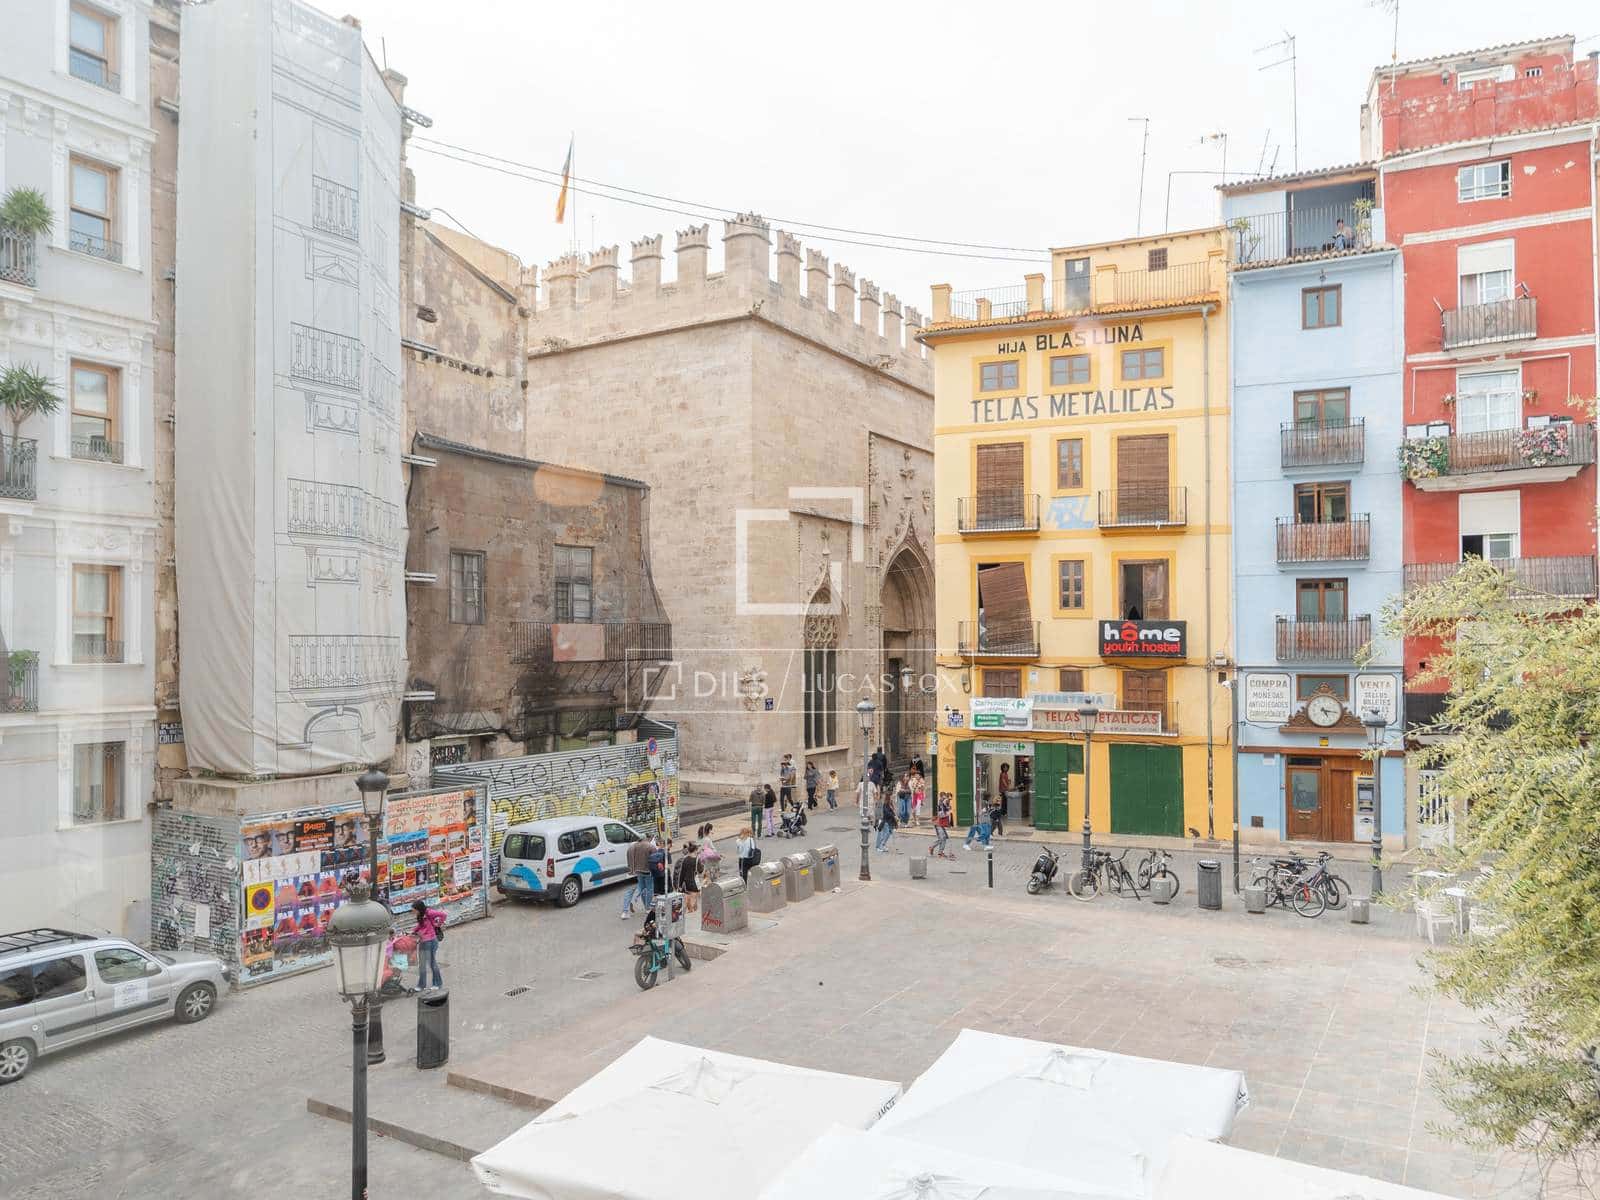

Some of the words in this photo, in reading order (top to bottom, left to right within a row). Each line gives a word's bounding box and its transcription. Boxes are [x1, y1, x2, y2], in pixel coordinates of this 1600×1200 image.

[998, 341, 1027, 355] HIJA
[1036, 332, 1087, 351] BLAS
[1093, 325, 1144, 345] LUNA
[971, 395, 1039, 424] TELAS
[1050, 386, 1175, 418] METALICAS
[1103, 642, 1139, 655] youth
[1141, 642, 1181, 653] hostel
[1249, 679, 1288, 688] COMPRA
[1359, 680, 1392, 689] VENTA
[1044, 711, 1081, 723] TELAS
[1095, 711, 1159, 725] ETALICAS
